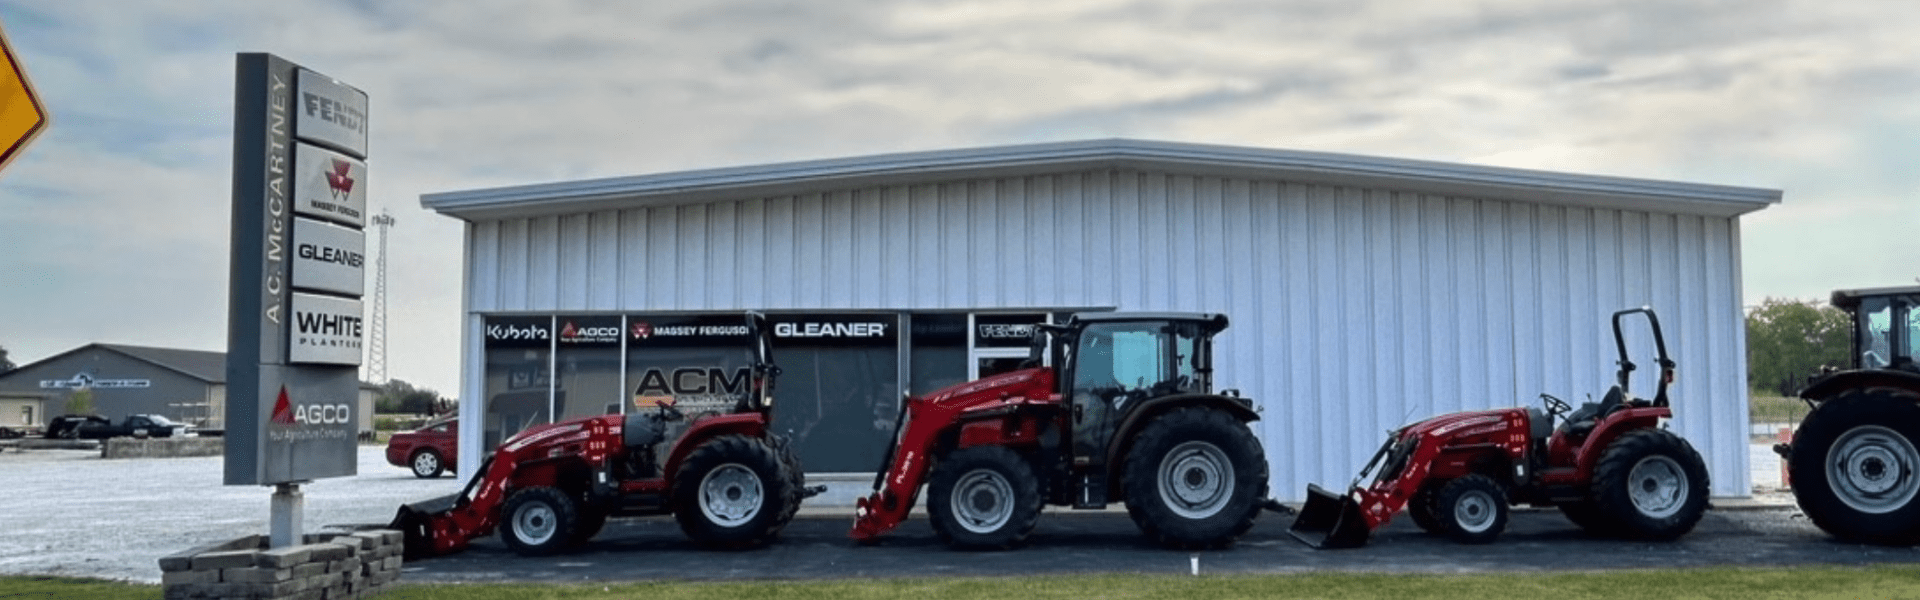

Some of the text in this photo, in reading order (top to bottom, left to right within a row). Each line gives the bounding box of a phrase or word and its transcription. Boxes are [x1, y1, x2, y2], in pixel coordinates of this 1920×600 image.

[303, 91, 365, 135] FENDT
[266, 74, 286, 323] A.C. McCARTNEY
[299, 244, 364, 268] GLEANER
[297, 312, 361, 337] WHITE
[487, 324, 547, 340] Kubota
[577, 327, 619, 337] AGCO
[654, 326, 697, 336] MASSEY
[775, 322, 884, 337] GLEANER
[294, 404, 349, 424] AGCO
